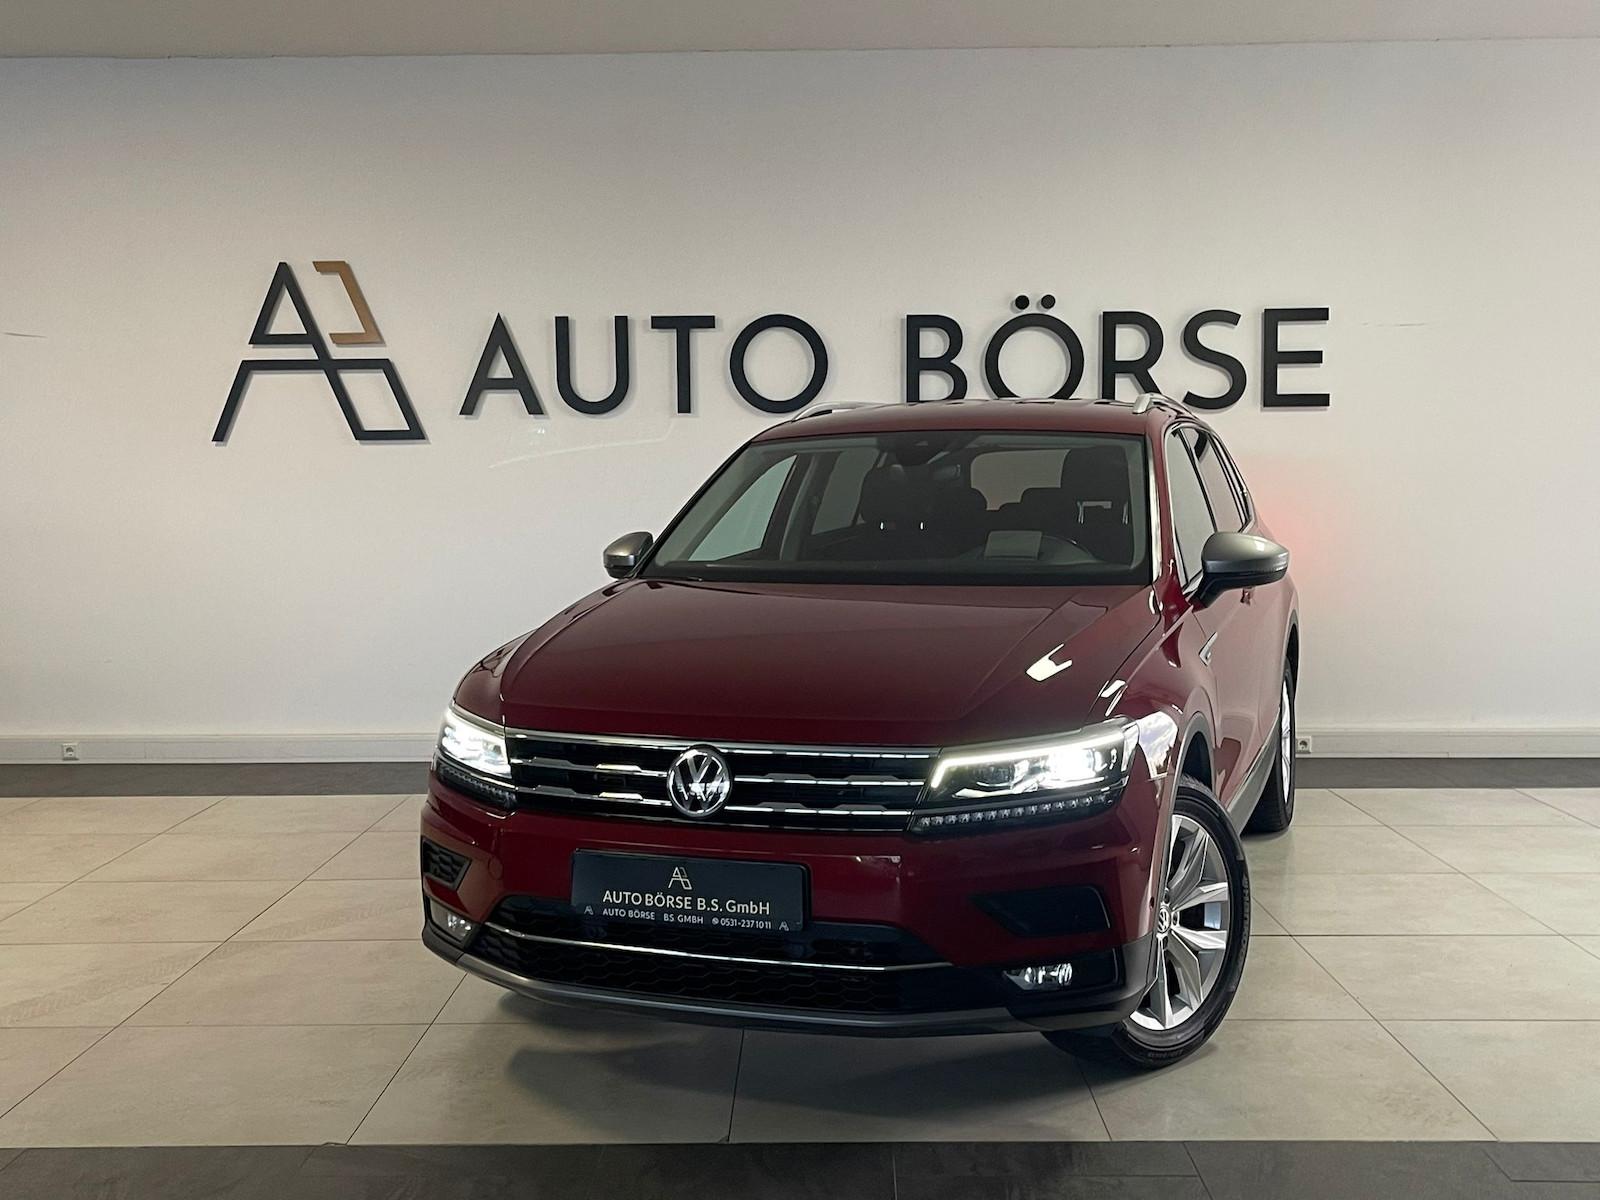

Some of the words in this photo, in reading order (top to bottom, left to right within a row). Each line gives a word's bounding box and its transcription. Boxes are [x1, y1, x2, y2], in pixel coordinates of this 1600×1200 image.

[459, 312, 829, 416] AUTO
[906, 294, 1331, 410] BÖRSE
[602, 890, 642, 905] AUTO
[645, 892, 692, 910] BÖRSE
[697, 897, 723, 912] B.S.
[726, 899, 769, 915] GmbH
[602, 908, 626, 917] AUTO
[663, 913, 675, 922] BS
[677, 914, 704, 925] GMBH
